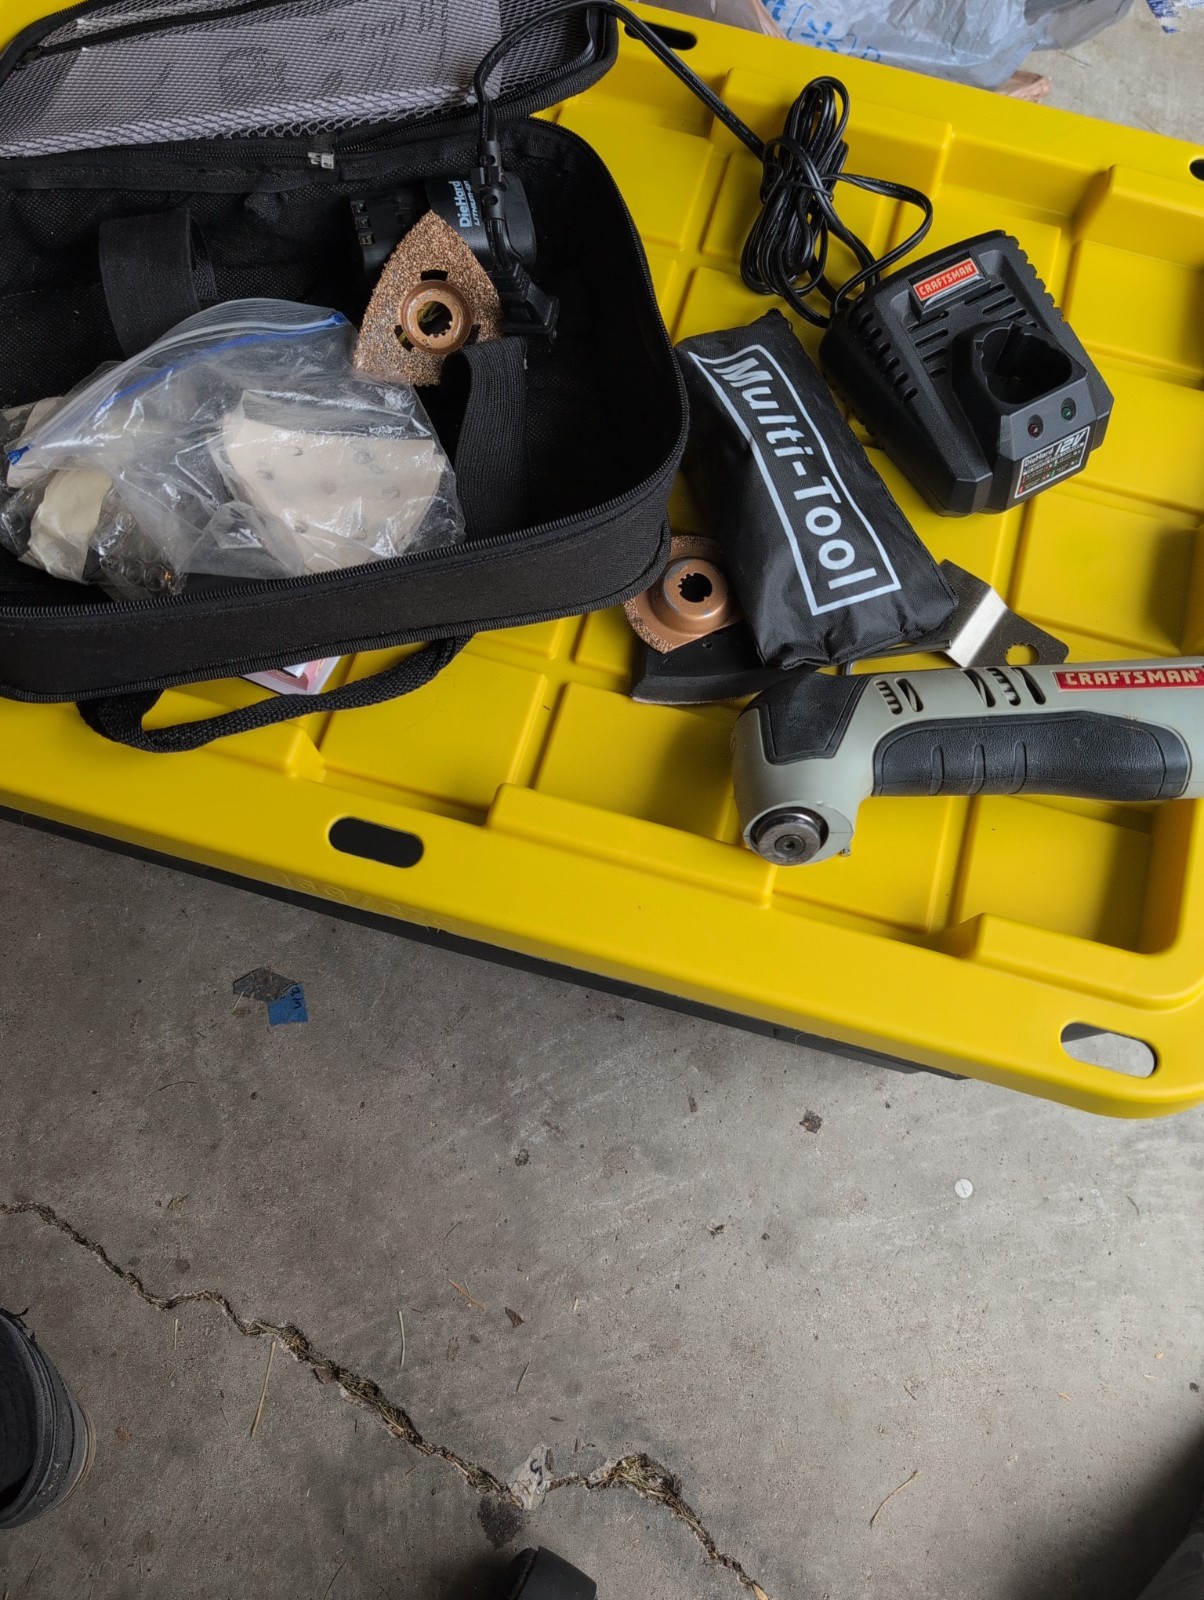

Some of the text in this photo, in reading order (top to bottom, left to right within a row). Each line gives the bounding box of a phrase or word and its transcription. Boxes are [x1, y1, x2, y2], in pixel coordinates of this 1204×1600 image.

[448, 180, 471, 228] DieHard
[918, 263, 974, 296] CRAFTSMAN
[1024, 446, 1054, 467] DieHard
[1054, 430, 1087, 457] 12V
[713, 357, 877, 590] Multi-Tool
[1065, 669, 1199, 686] CRAFTSMAN
